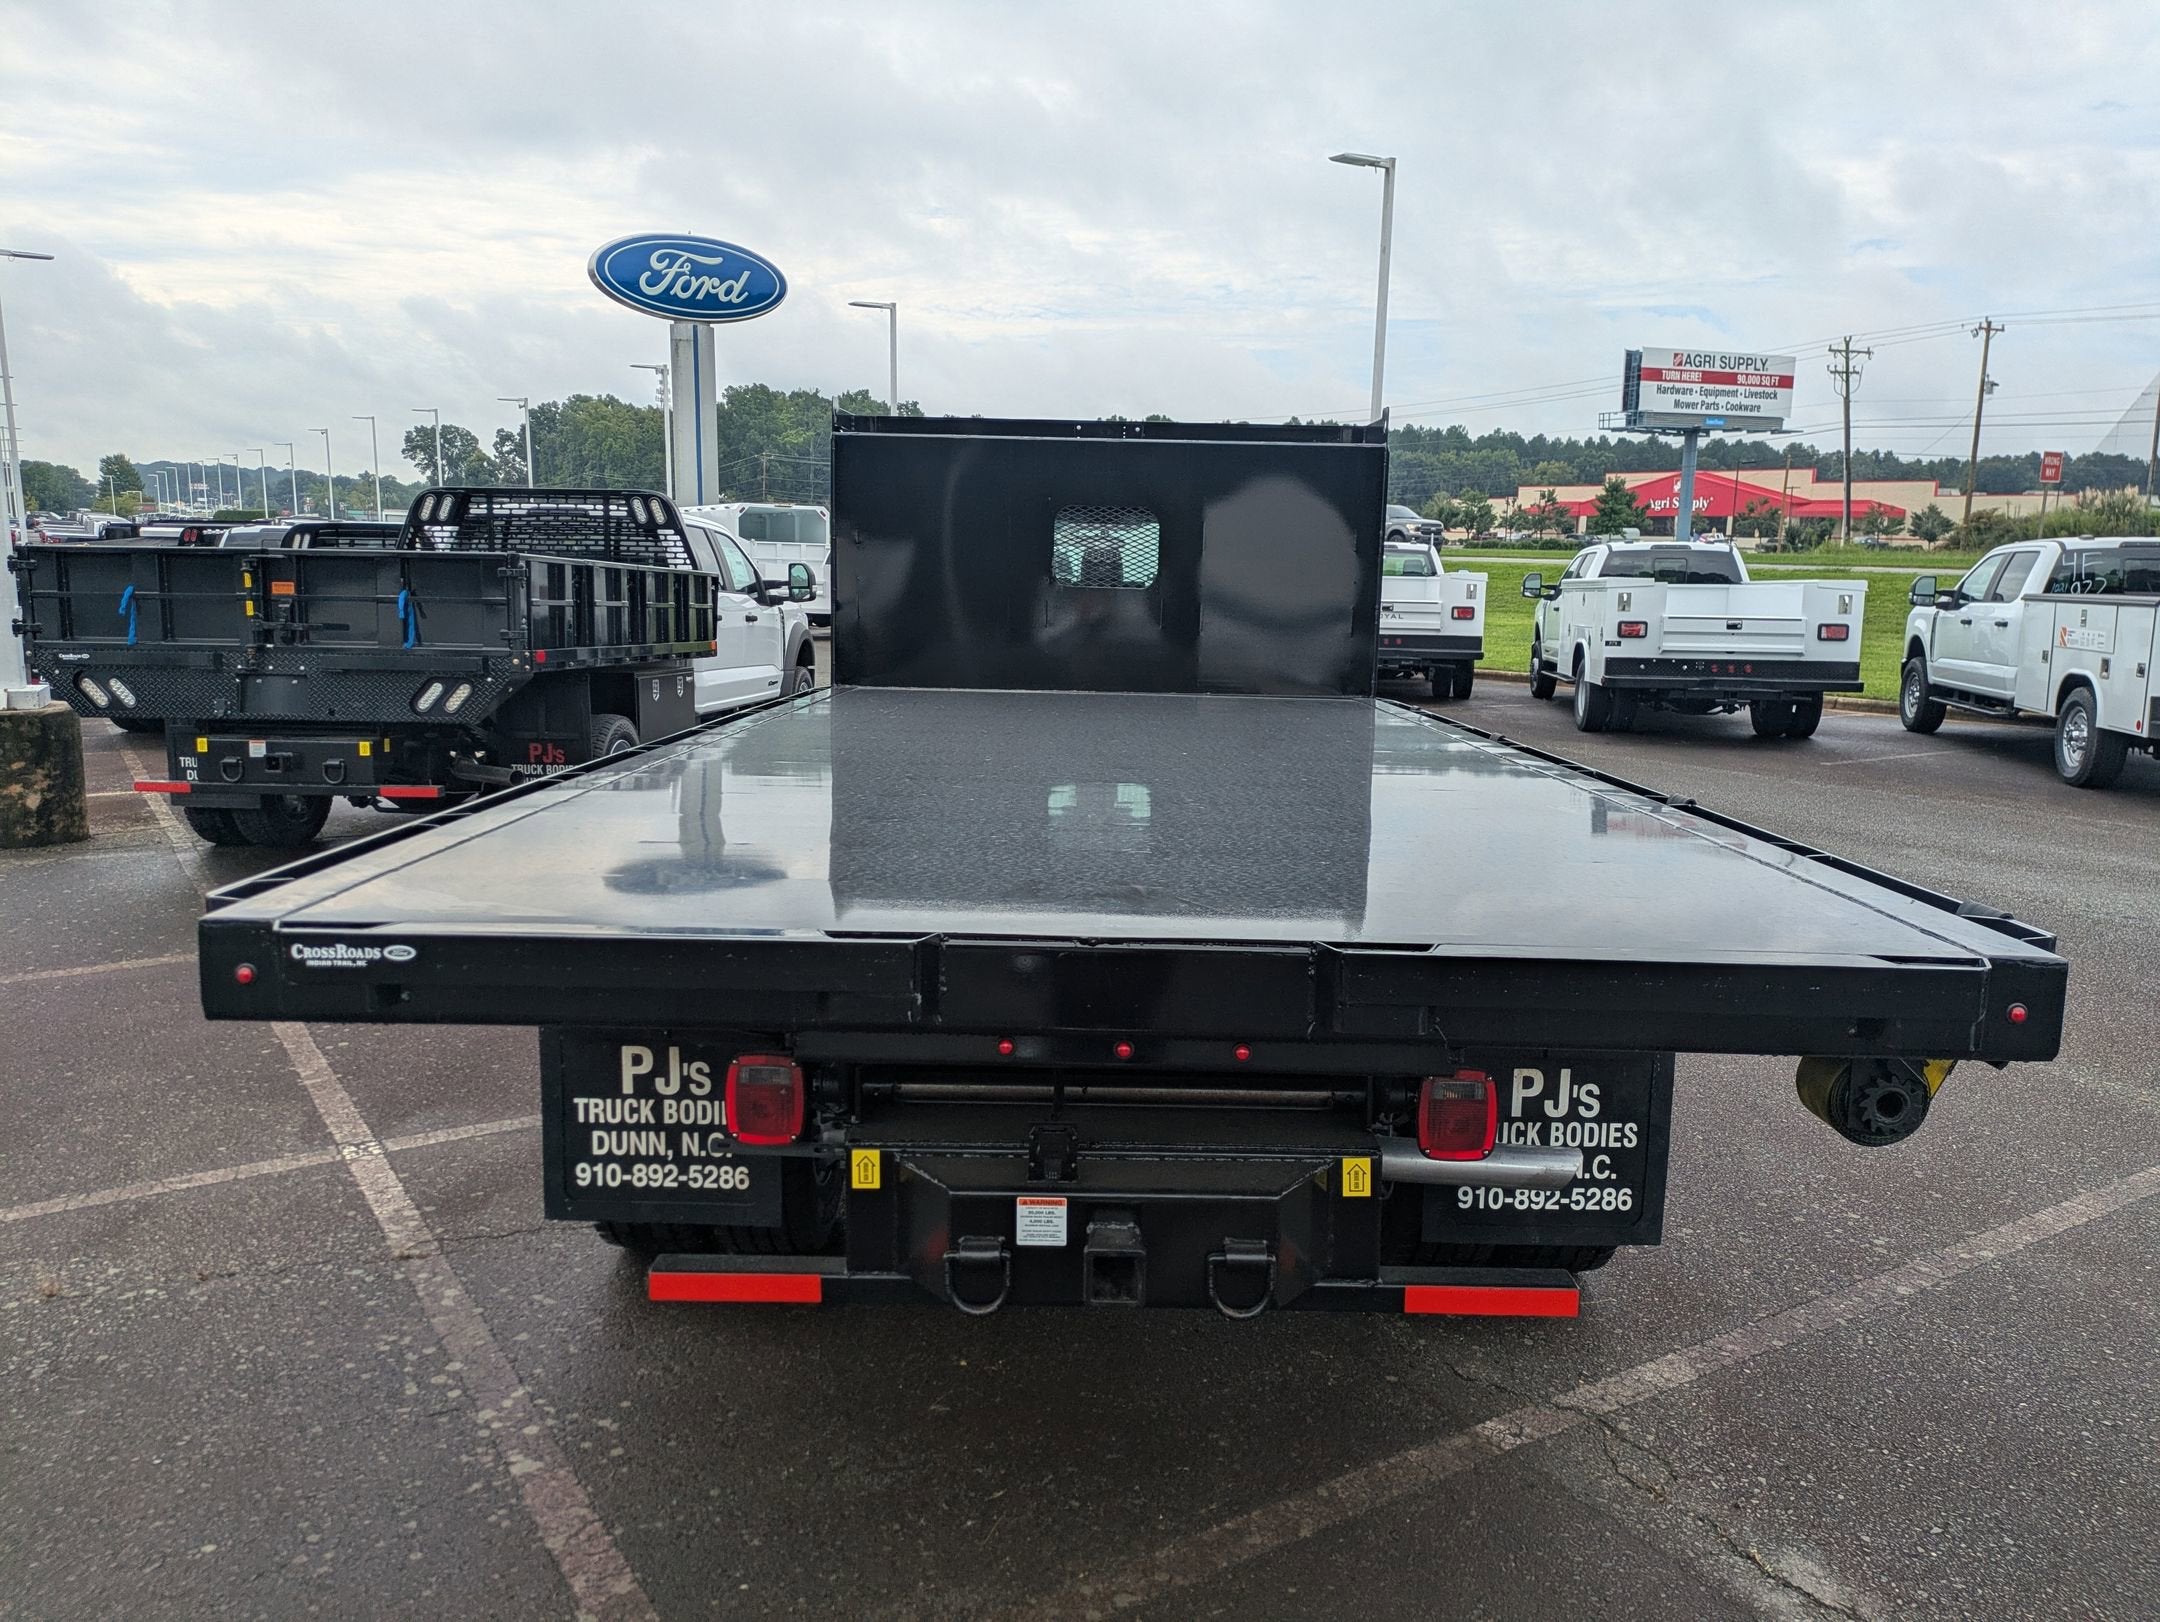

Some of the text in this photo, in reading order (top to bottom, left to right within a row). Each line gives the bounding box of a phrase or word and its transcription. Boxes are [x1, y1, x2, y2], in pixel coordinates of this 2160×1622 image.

[639, 249, 752, 304] Ford
[1683, 353, 1716, 369] AGRI
[1661, 370, 1702, 382] TURN HERE!
[1737, 374, 1779, 386] 90,000 SQ FT
[1656, 384, 1778, 400] Hardware Equipment Livestock
[1673, 399, 1761, 413] Mower Parts Cookware
[1672, 496, 1709, 512] Sply
[179, 756, 198, 768] TRU
[573, 1097, 727, 1126] TRUCK BODI
[1496, 1121, 1638, 1148] UCK BODIES
[592, 1130, 673, 1161] DUNN,
[575, 1162, 750, 1190] 910-892-5286
[1457, 1186, 1633, 1212] 910-892-5286
